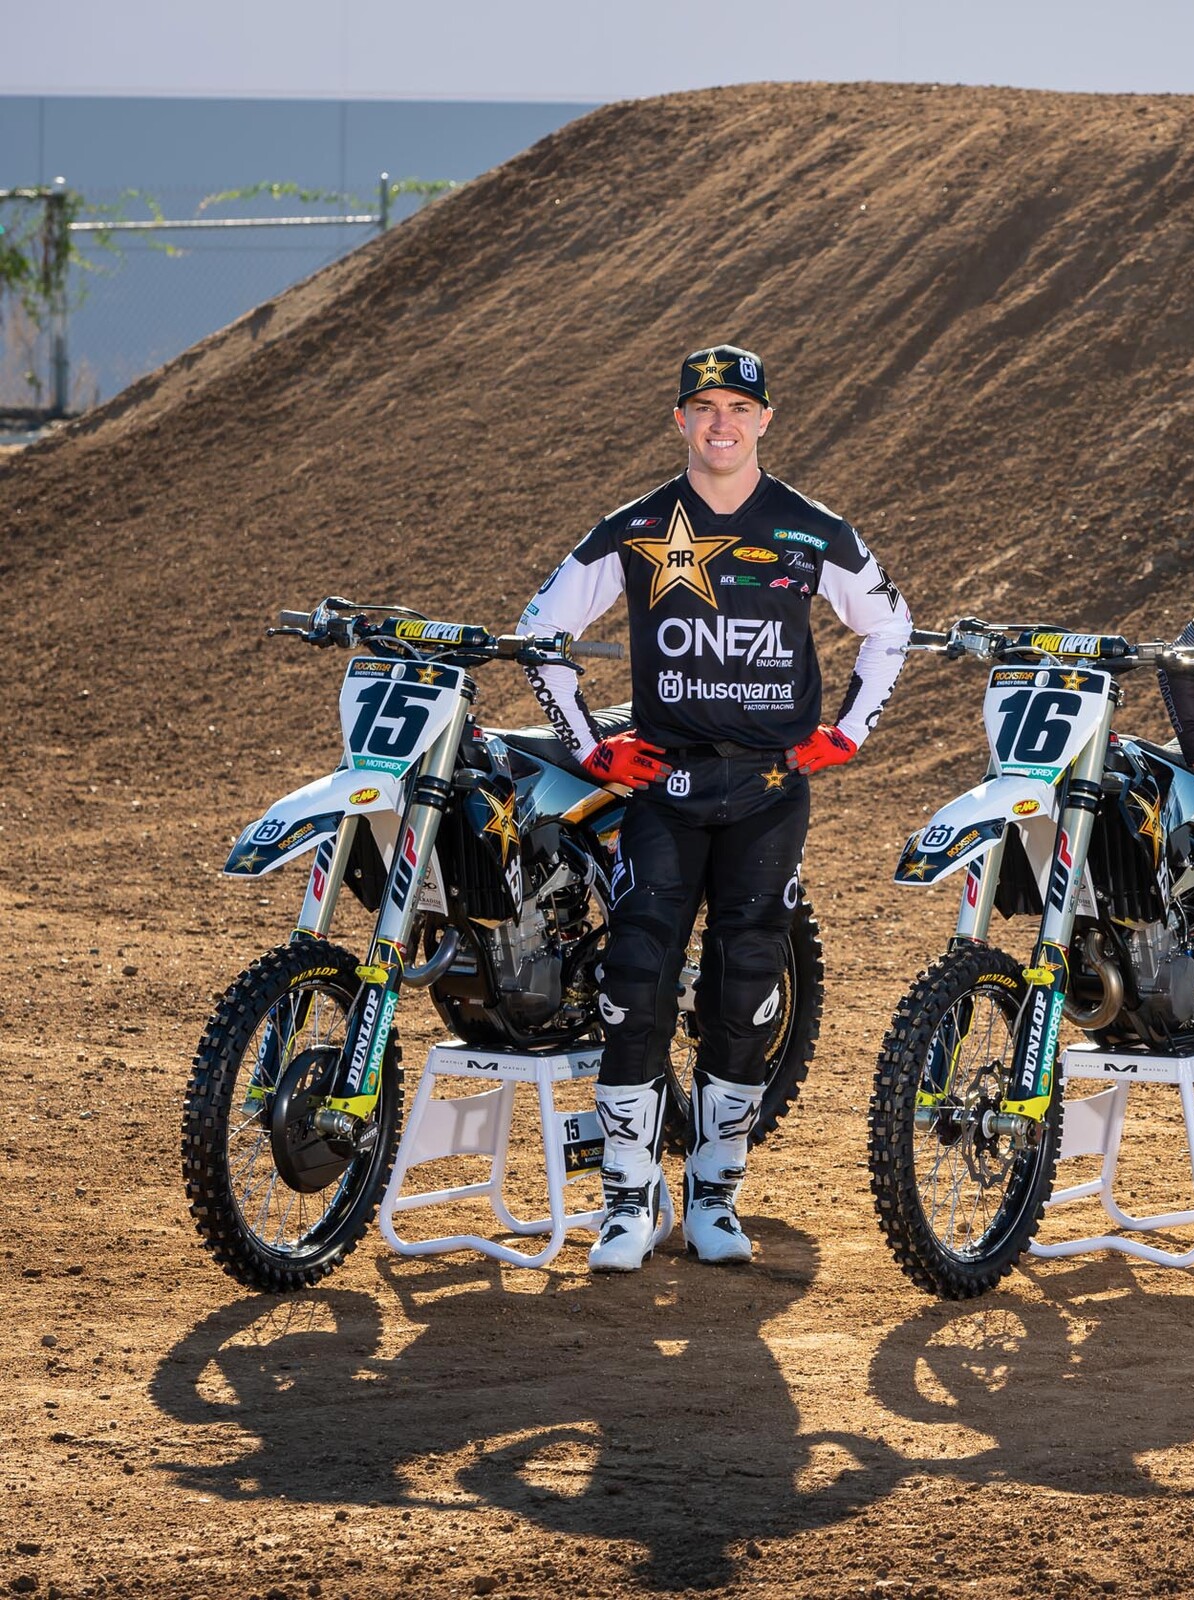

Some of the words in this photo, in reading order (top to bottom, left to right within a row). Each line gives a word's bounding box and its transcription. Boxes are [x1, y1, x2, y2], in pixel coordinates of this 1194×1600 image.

[787, 531, 825, 550] MOTOREX
[353, 662, 392, 672] ROCKSTAR
[994, 671, 1035, 680] ROCKSTAR
[687, 678, 793, 703] Husqvarna
[524, 665, 582, 751] ROCKSTAR
[743, 703, 770, 711] FACTORY
[349, 681, 442, 758] 15
[995, 690, 1082, 764] 16
[365, 759, 402, 770] MOTOREX
[350, 788, 380, 804] FMF
[1013, 800, 1040, 814] FMF
[278, 822, 315, 850] ROCKSTAR
[947, 830, 981, 858] ROCKSTAR
[288, 966, 338, 988] DUNLOP
[975, 973, 1019, 988] DUNLOP
[346, 988, 380, 1090] DUNLOP
[370, 995, 397, 1071] MOTOREX
[1021, 990, 1047, 1092] DUNLOP
[1042, 995, 1064, 1072] MOTOREX
[563, 1118, 580, 1142] 15
